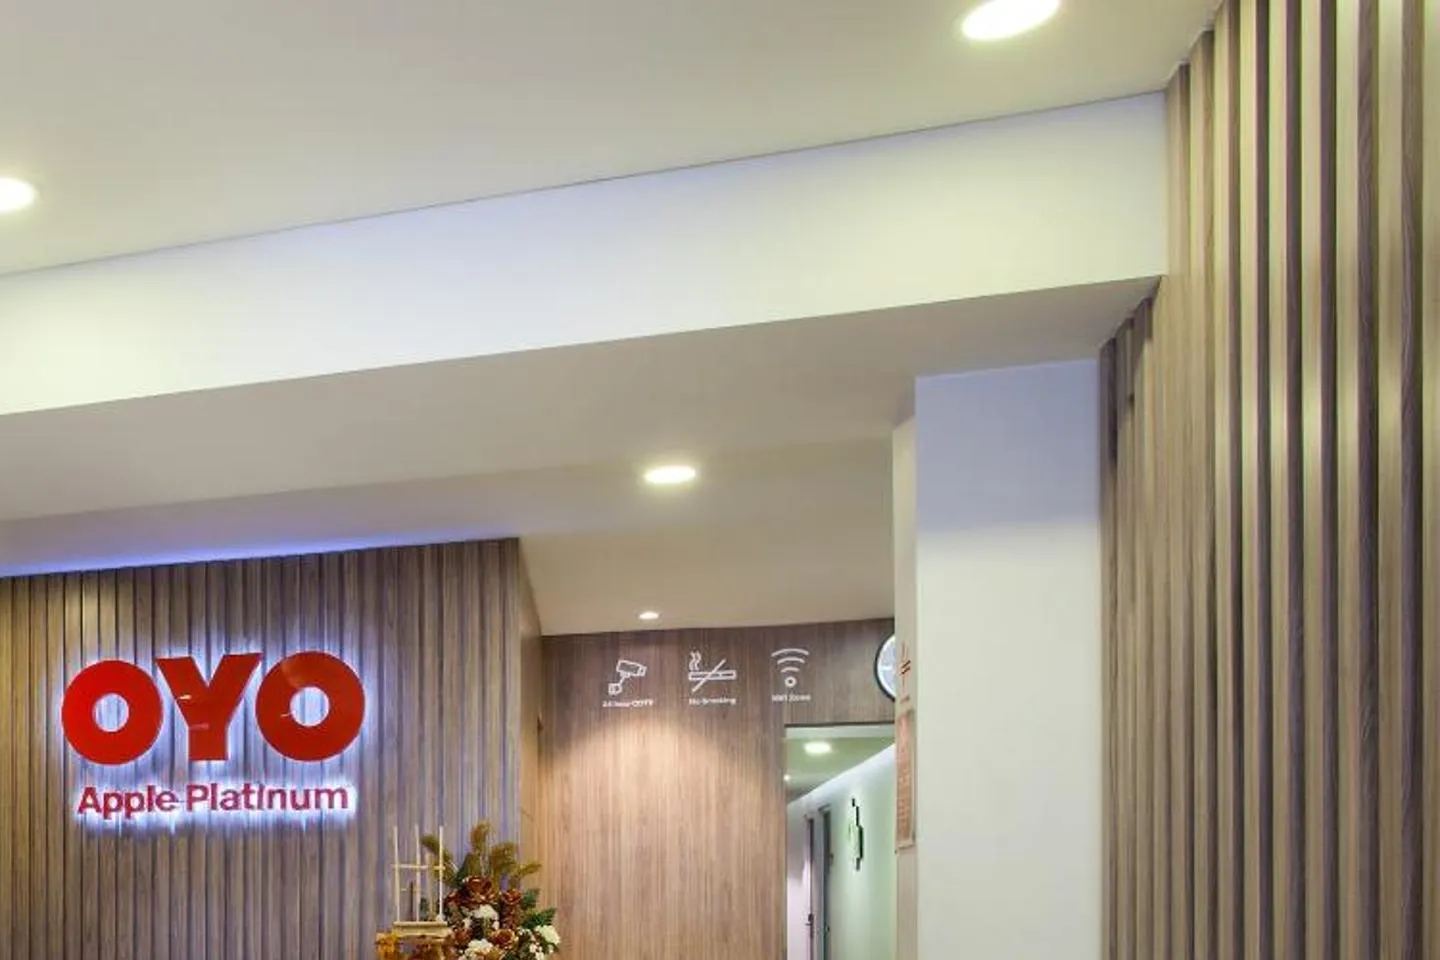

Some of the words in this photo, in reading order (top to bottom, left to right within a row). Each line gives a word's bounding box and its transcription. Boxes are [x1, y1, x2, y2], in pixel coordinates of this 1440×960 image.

[61, 651, 365, 765] OYO
[78, 783, 178, 819] Apple
[185, 780, 348, 811] Platinum
